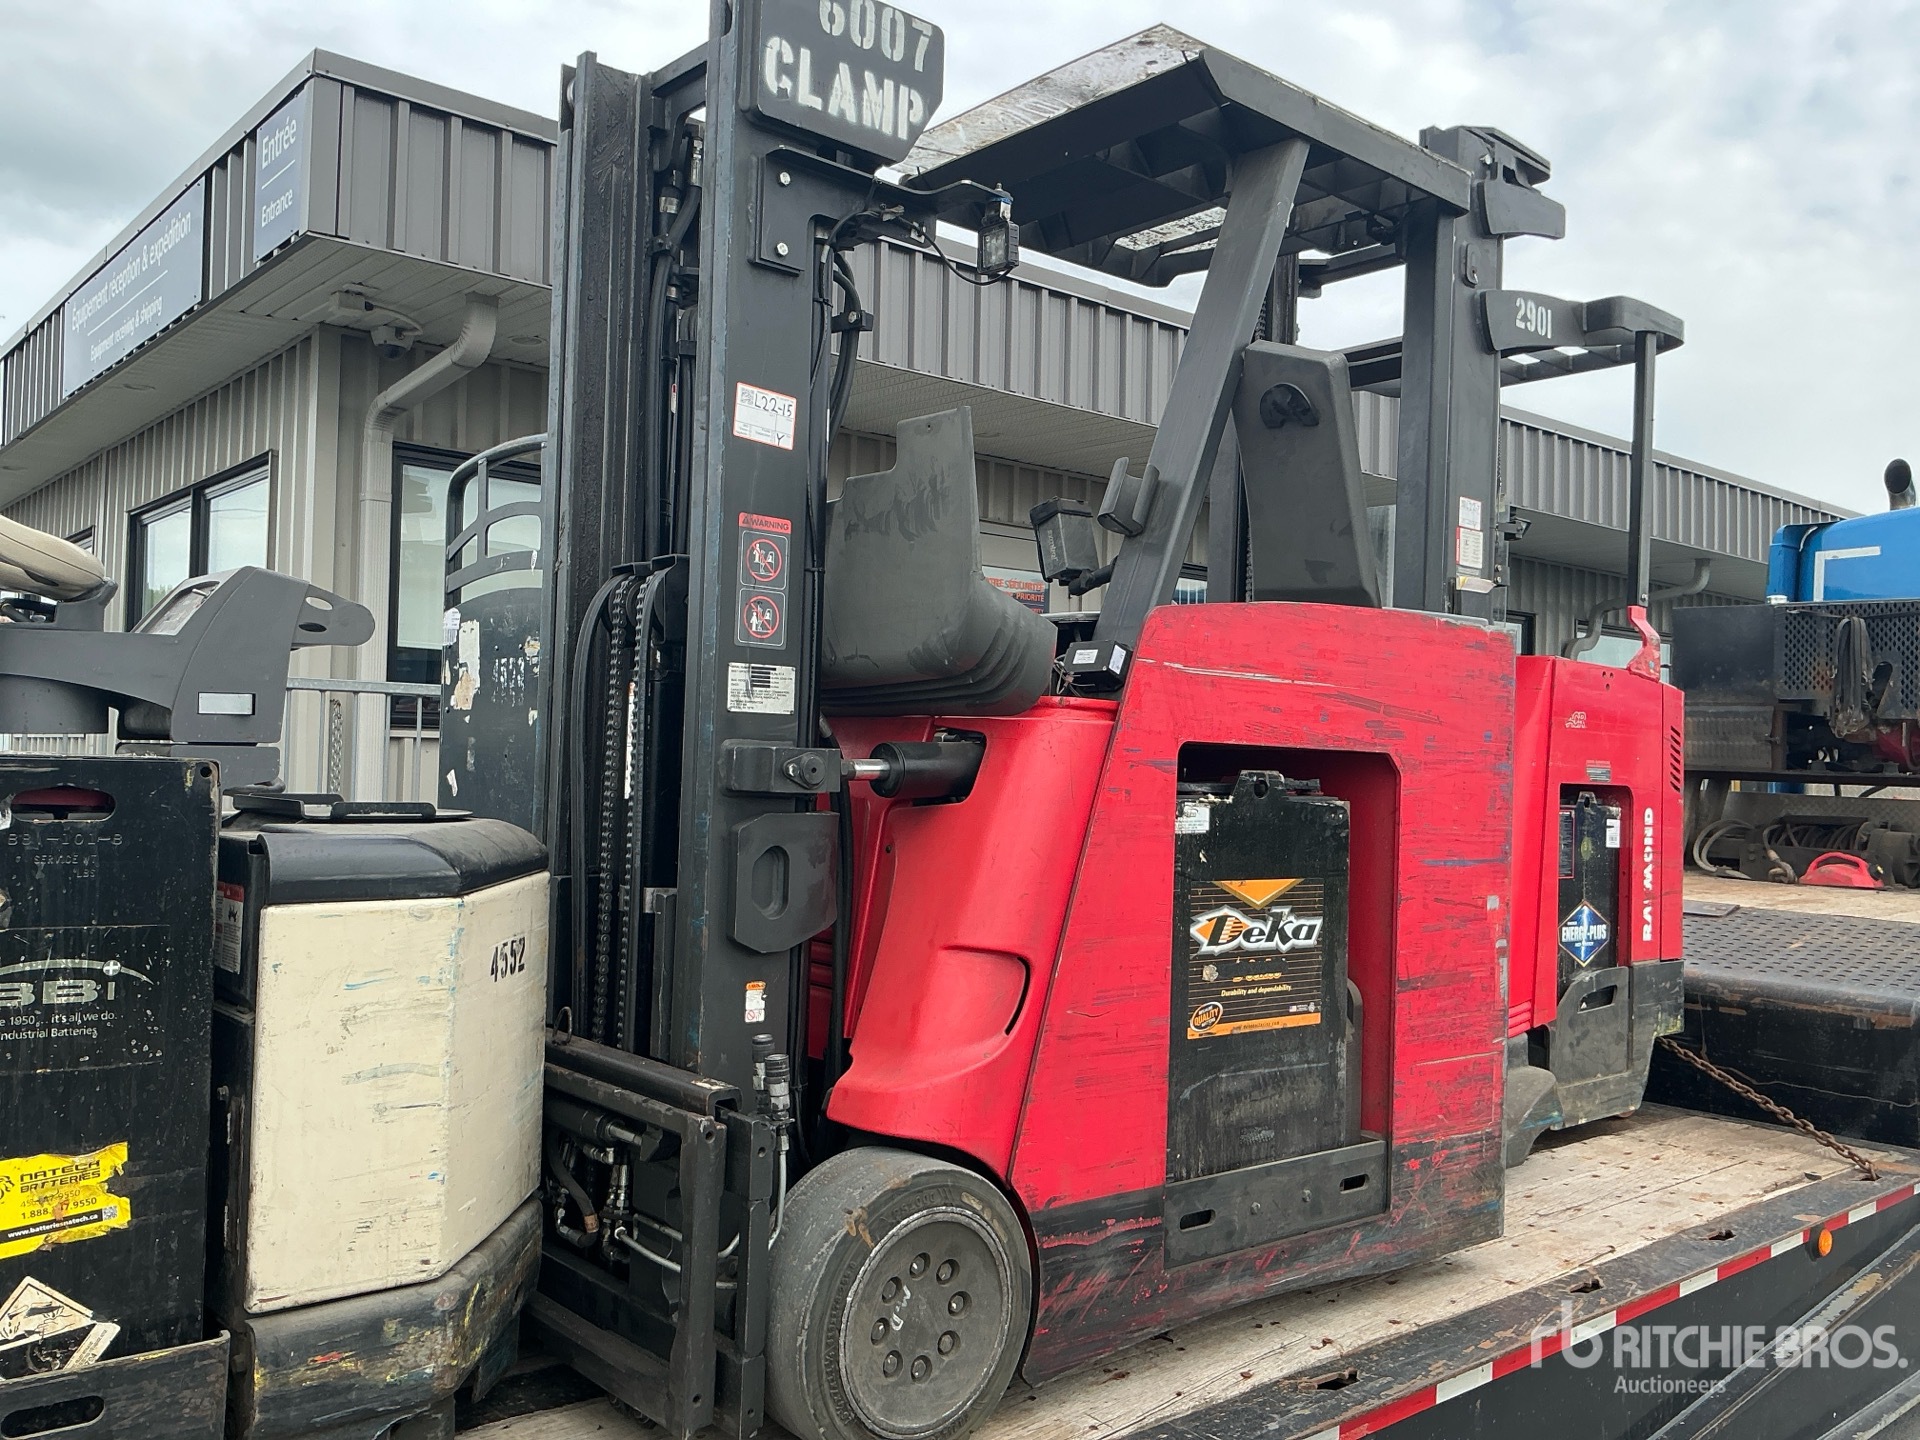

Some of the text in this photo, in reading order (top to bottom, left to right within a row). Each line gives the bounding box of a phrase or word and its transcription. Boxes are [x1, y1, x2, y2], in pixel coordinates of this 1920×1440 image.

[819, 0, 932, 72] 6007
[765, 37, 925, 140] CLAMP
[262, 116, 297, 170] Entrée
[261, 189, 293, 228] Entrance
[108, 256, 141, 298] réception
[142, 244, 149, 271] &
[150, 211, 191, 266] expédition
[90, 296, 163, 363] Equipment receiving & shipping
[1515, 297, 1552, 339] 2901
[755, 393, 793, 417] L22-15
[750, 518, 789, 530] WARNING
[1642, 807, 1654, 941] RAMOND
[1204, 908, 1319, 948] Deka
[490, 937, 526, 982] 4552
[1221, 987, 1246, 997] Durability
[1248, 986, 1258, 995] and
[51, 1013, 67, 1023] it's
[69, 1011, 80, 1023] all
[83, 1013, 98, 1021] we
[101, 1010, 117, 1021] do.
[1194, 1007, 1219, 1027] QUALITY
[0, 1026, 97, 1040] ndustrial Batteries
[20, 1160, 100, 1183] NATECH
[20, 1170, 101, 1193] BATTERIES
[21, 1198, 97, 1220] 1.888.7.9550
[8, 1214, 98, 1238] www.batteriesnatech.ca
